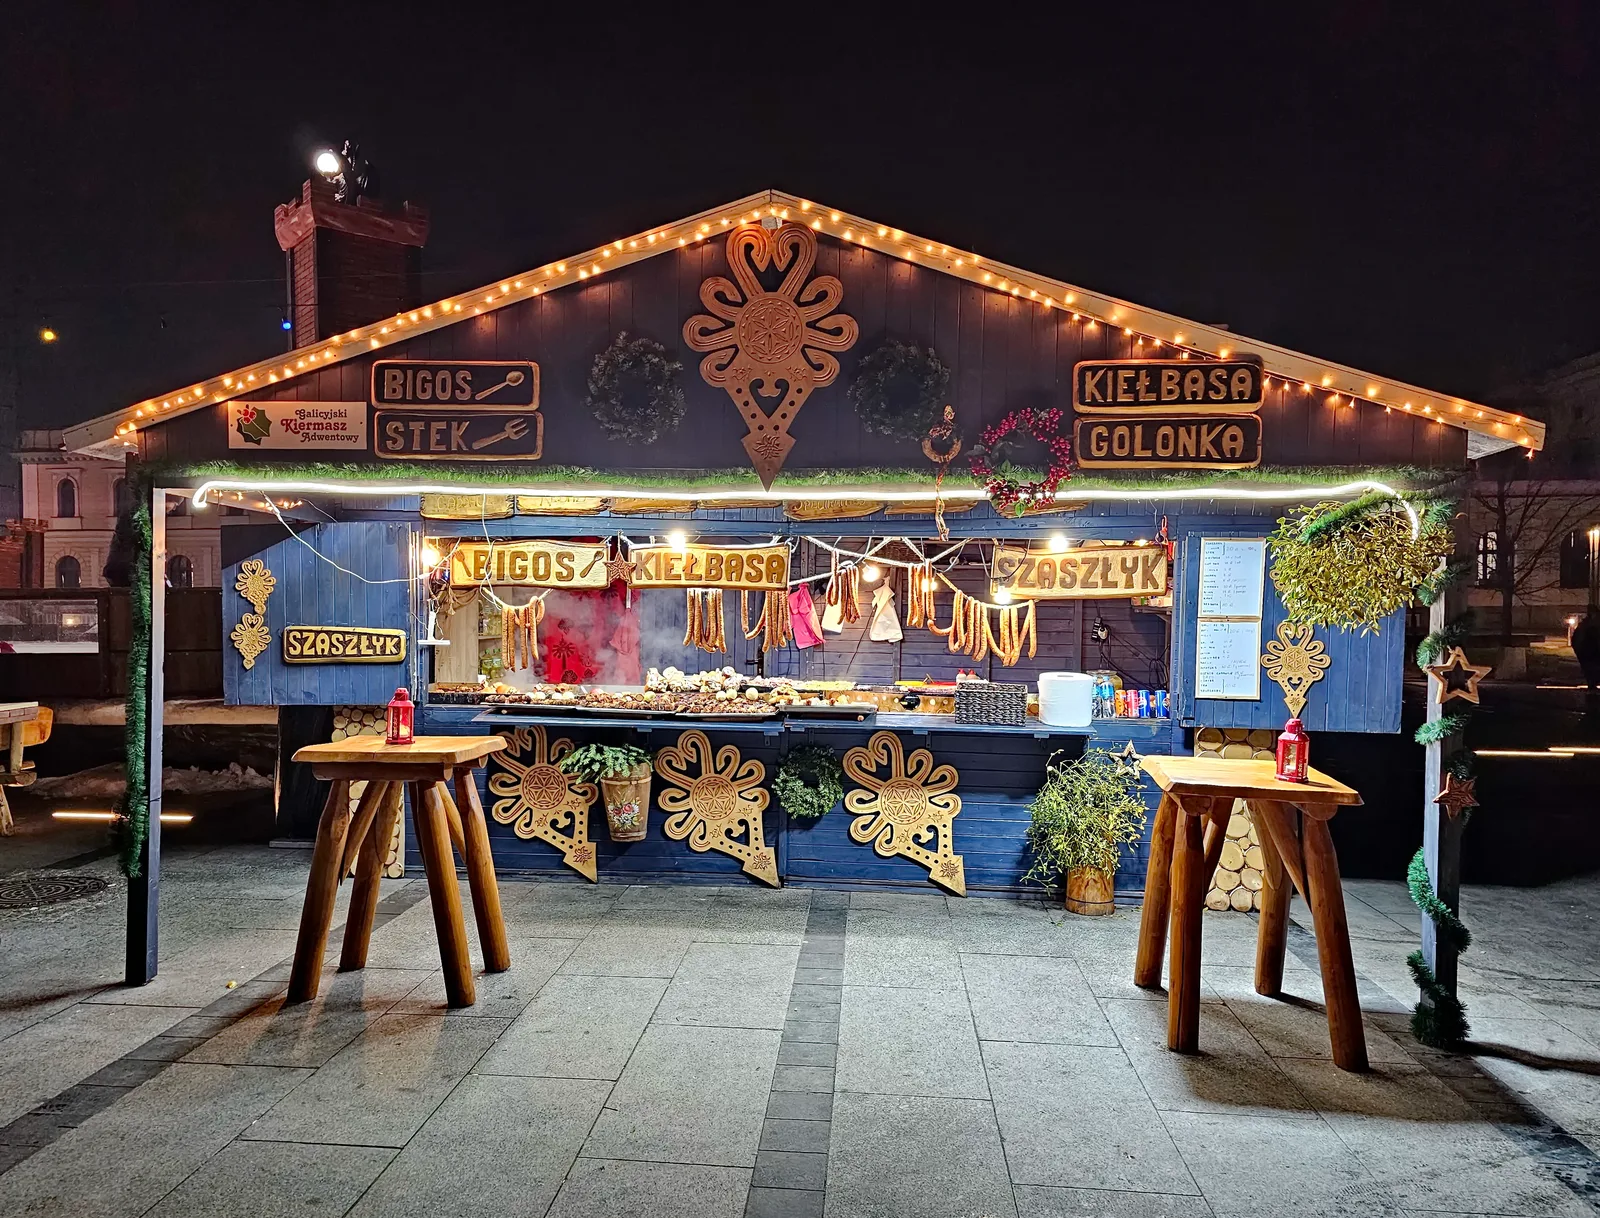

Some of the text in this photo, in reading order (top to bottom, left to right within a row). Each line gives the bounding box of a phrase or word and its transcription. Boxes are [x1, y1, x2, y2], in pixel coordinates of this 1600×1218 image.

[383, 369, 473, 401] BIGOS
[1084, 368, 1253, 402] KIEŁBASA
[281, 418, 347, 434] Kiermasz
[295, 408, 348, 420] Galicyjski
[300, 432, 360, 443] Adwentowy
[385, 420, 471, 451] STEK
[1090, 423, 1244, 459] GOLONKA
[473, 550, 575, 582] BIGOS
[635, 552, 785, 583] KIEŁBASA
[997, 553, 1165, 589] SZASZŁYK
[288, 631, 400, 656] SZASZŁYK
